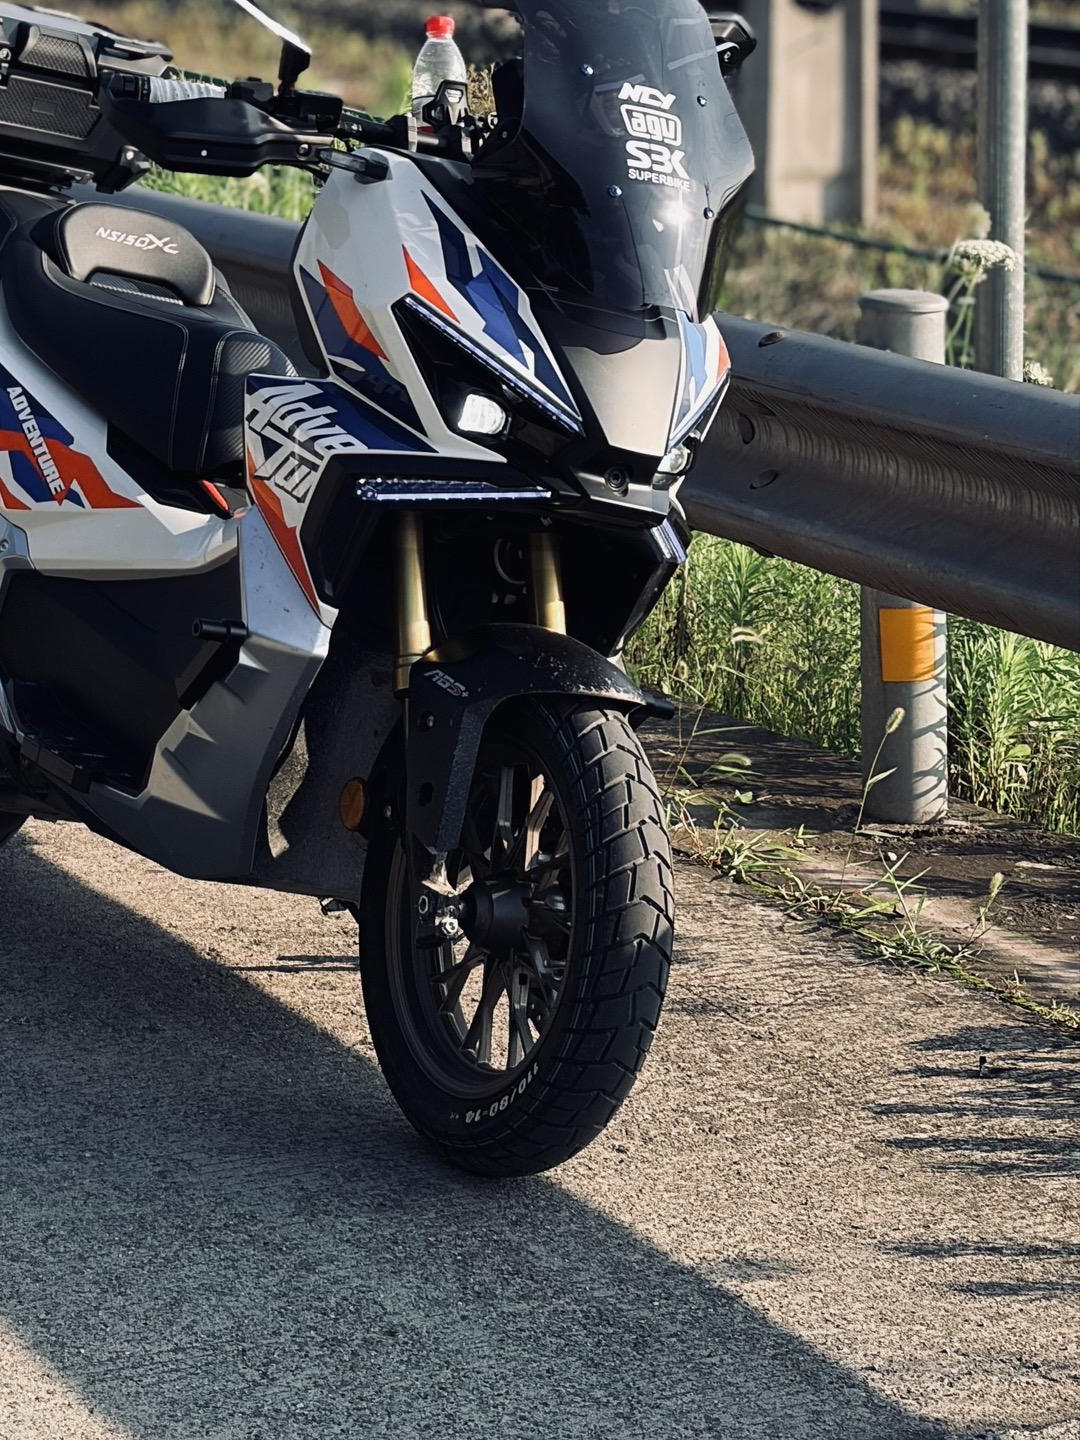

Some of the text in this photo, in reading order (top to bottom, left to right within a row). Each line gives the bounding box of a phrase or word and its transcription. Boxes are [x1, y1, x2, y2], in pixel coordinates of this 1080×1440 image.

[631, 111, 676, 142] agv
[625, 140, 690, 180] SBK
[628, 168, 691, 192] SUPERBIKE
[7, 386, 66, 496] ADVENTURE
